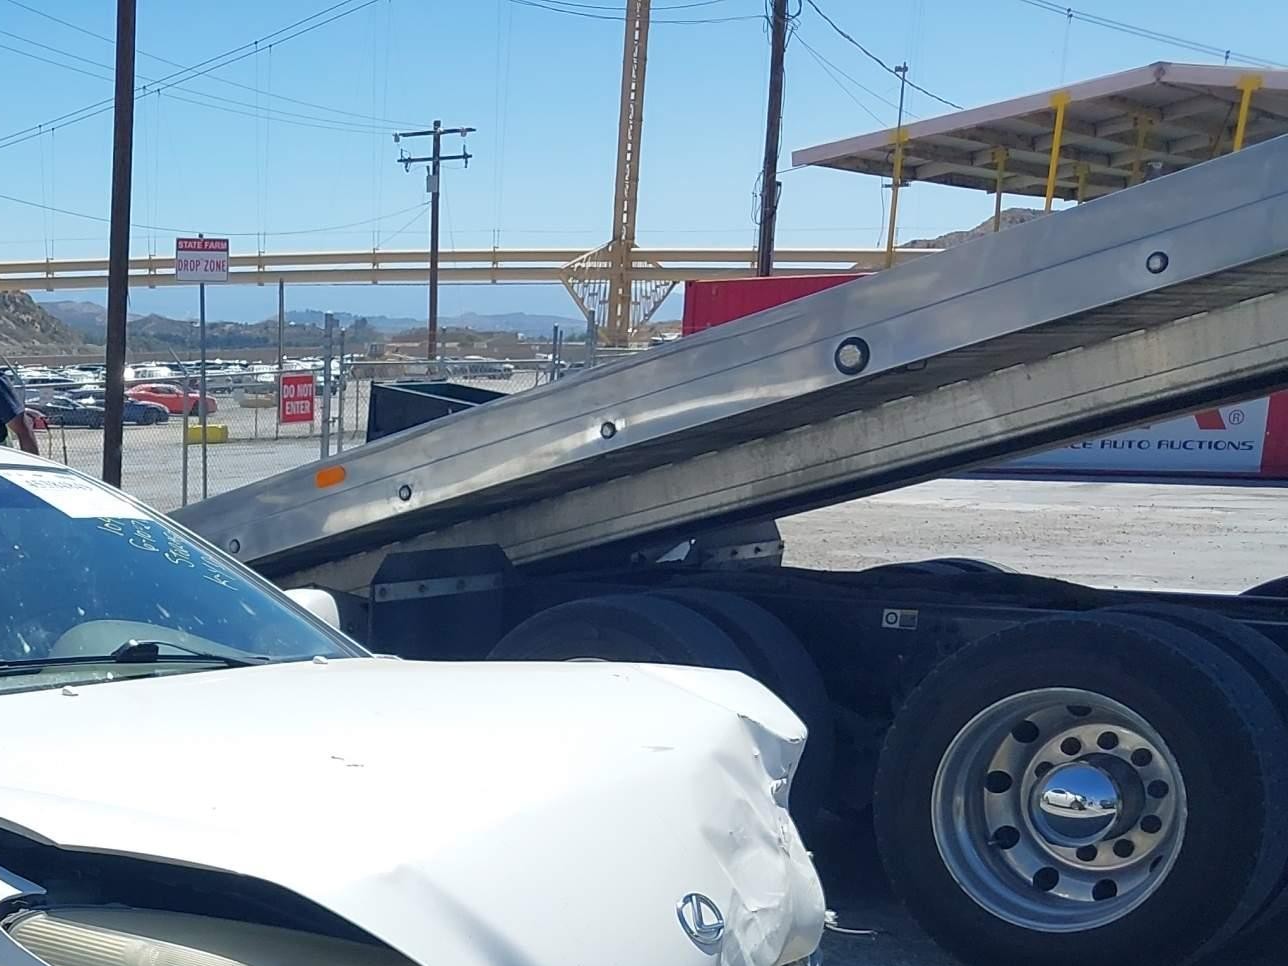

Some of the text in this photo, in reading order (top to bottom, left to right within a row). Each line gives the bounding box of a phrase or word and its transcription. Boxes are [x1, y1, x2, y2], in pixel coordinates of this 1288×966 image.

[178, 240, 227, 250] STATE FARM
[178, 259, 227, 273] DROP ZONE
[283, 383, 313, 399] DO NOT
[285, 400, 311, 415] ENTER
[1100, 439, 1152, 450] AUTO
[1157, 439, 1254, 451] AUCTIONS
